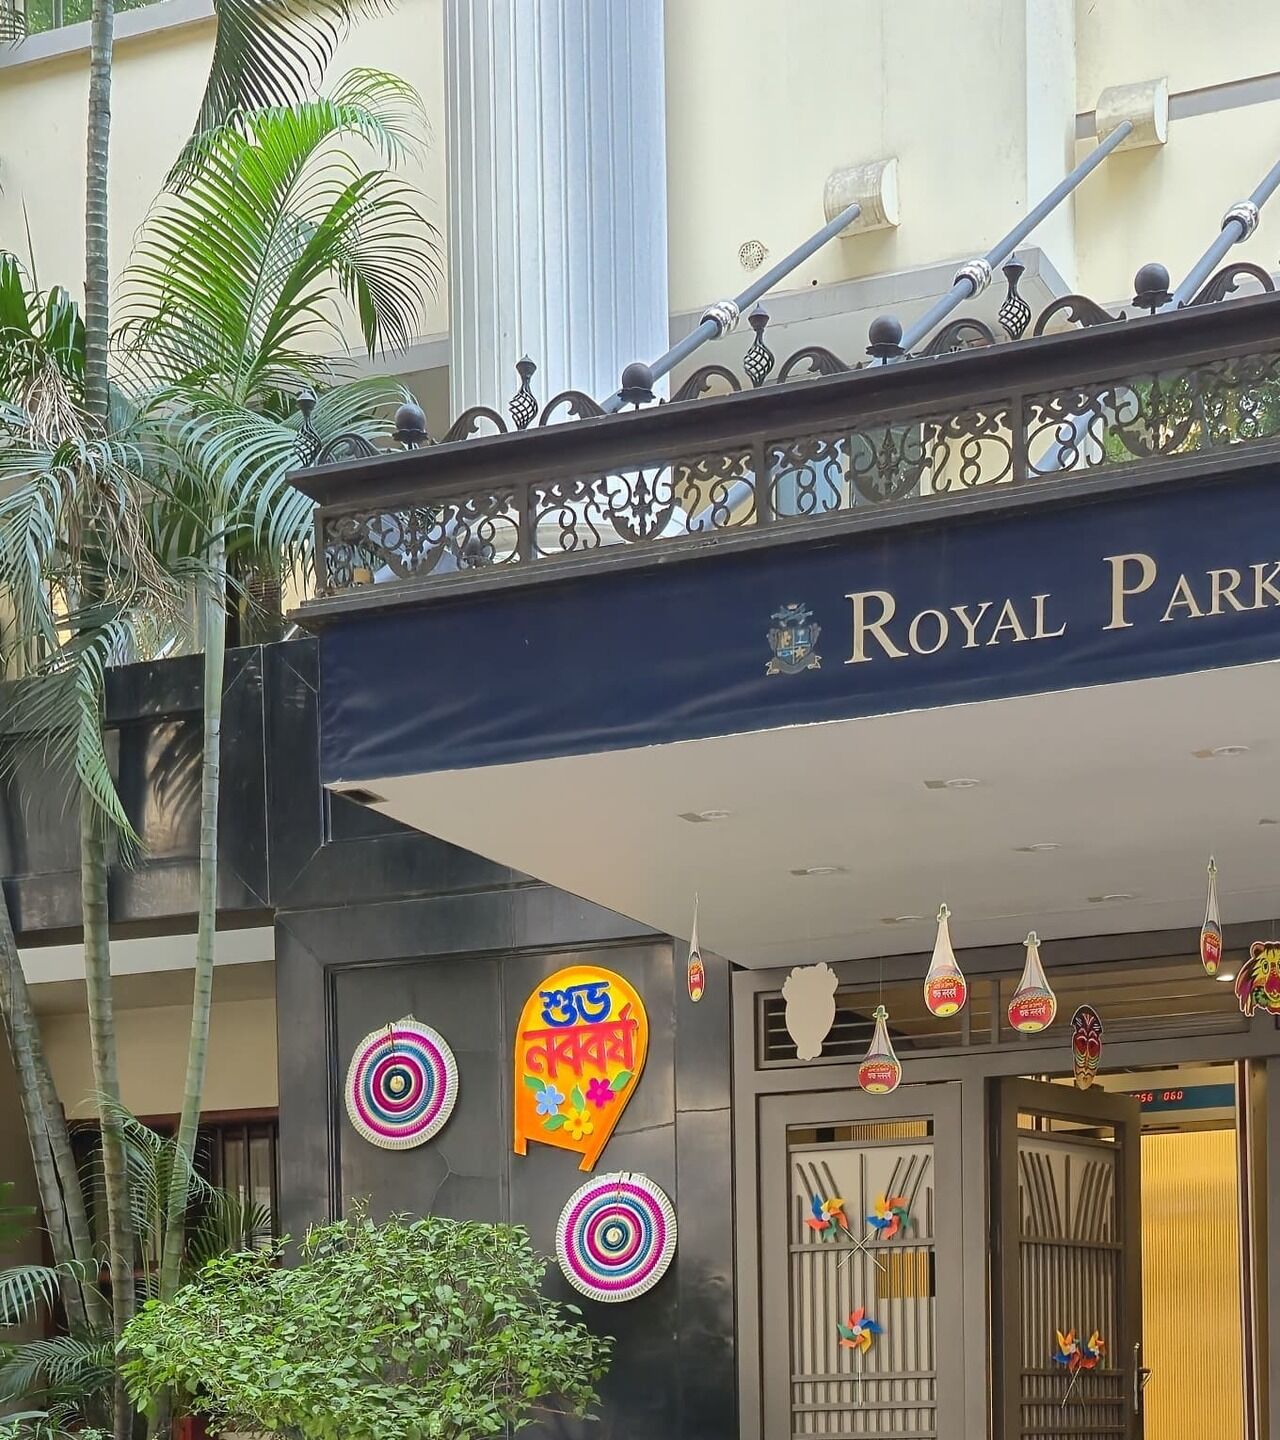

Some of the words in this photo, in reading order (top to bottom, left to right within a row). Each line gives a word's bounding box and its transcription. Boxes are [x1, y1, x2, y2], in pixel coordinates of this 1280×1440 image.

[844, 588, 1067, 665] ROYAL
[522, 1002, 640, 1079] নববর্ষ
[538, 981, 612, 1029] শুভ
